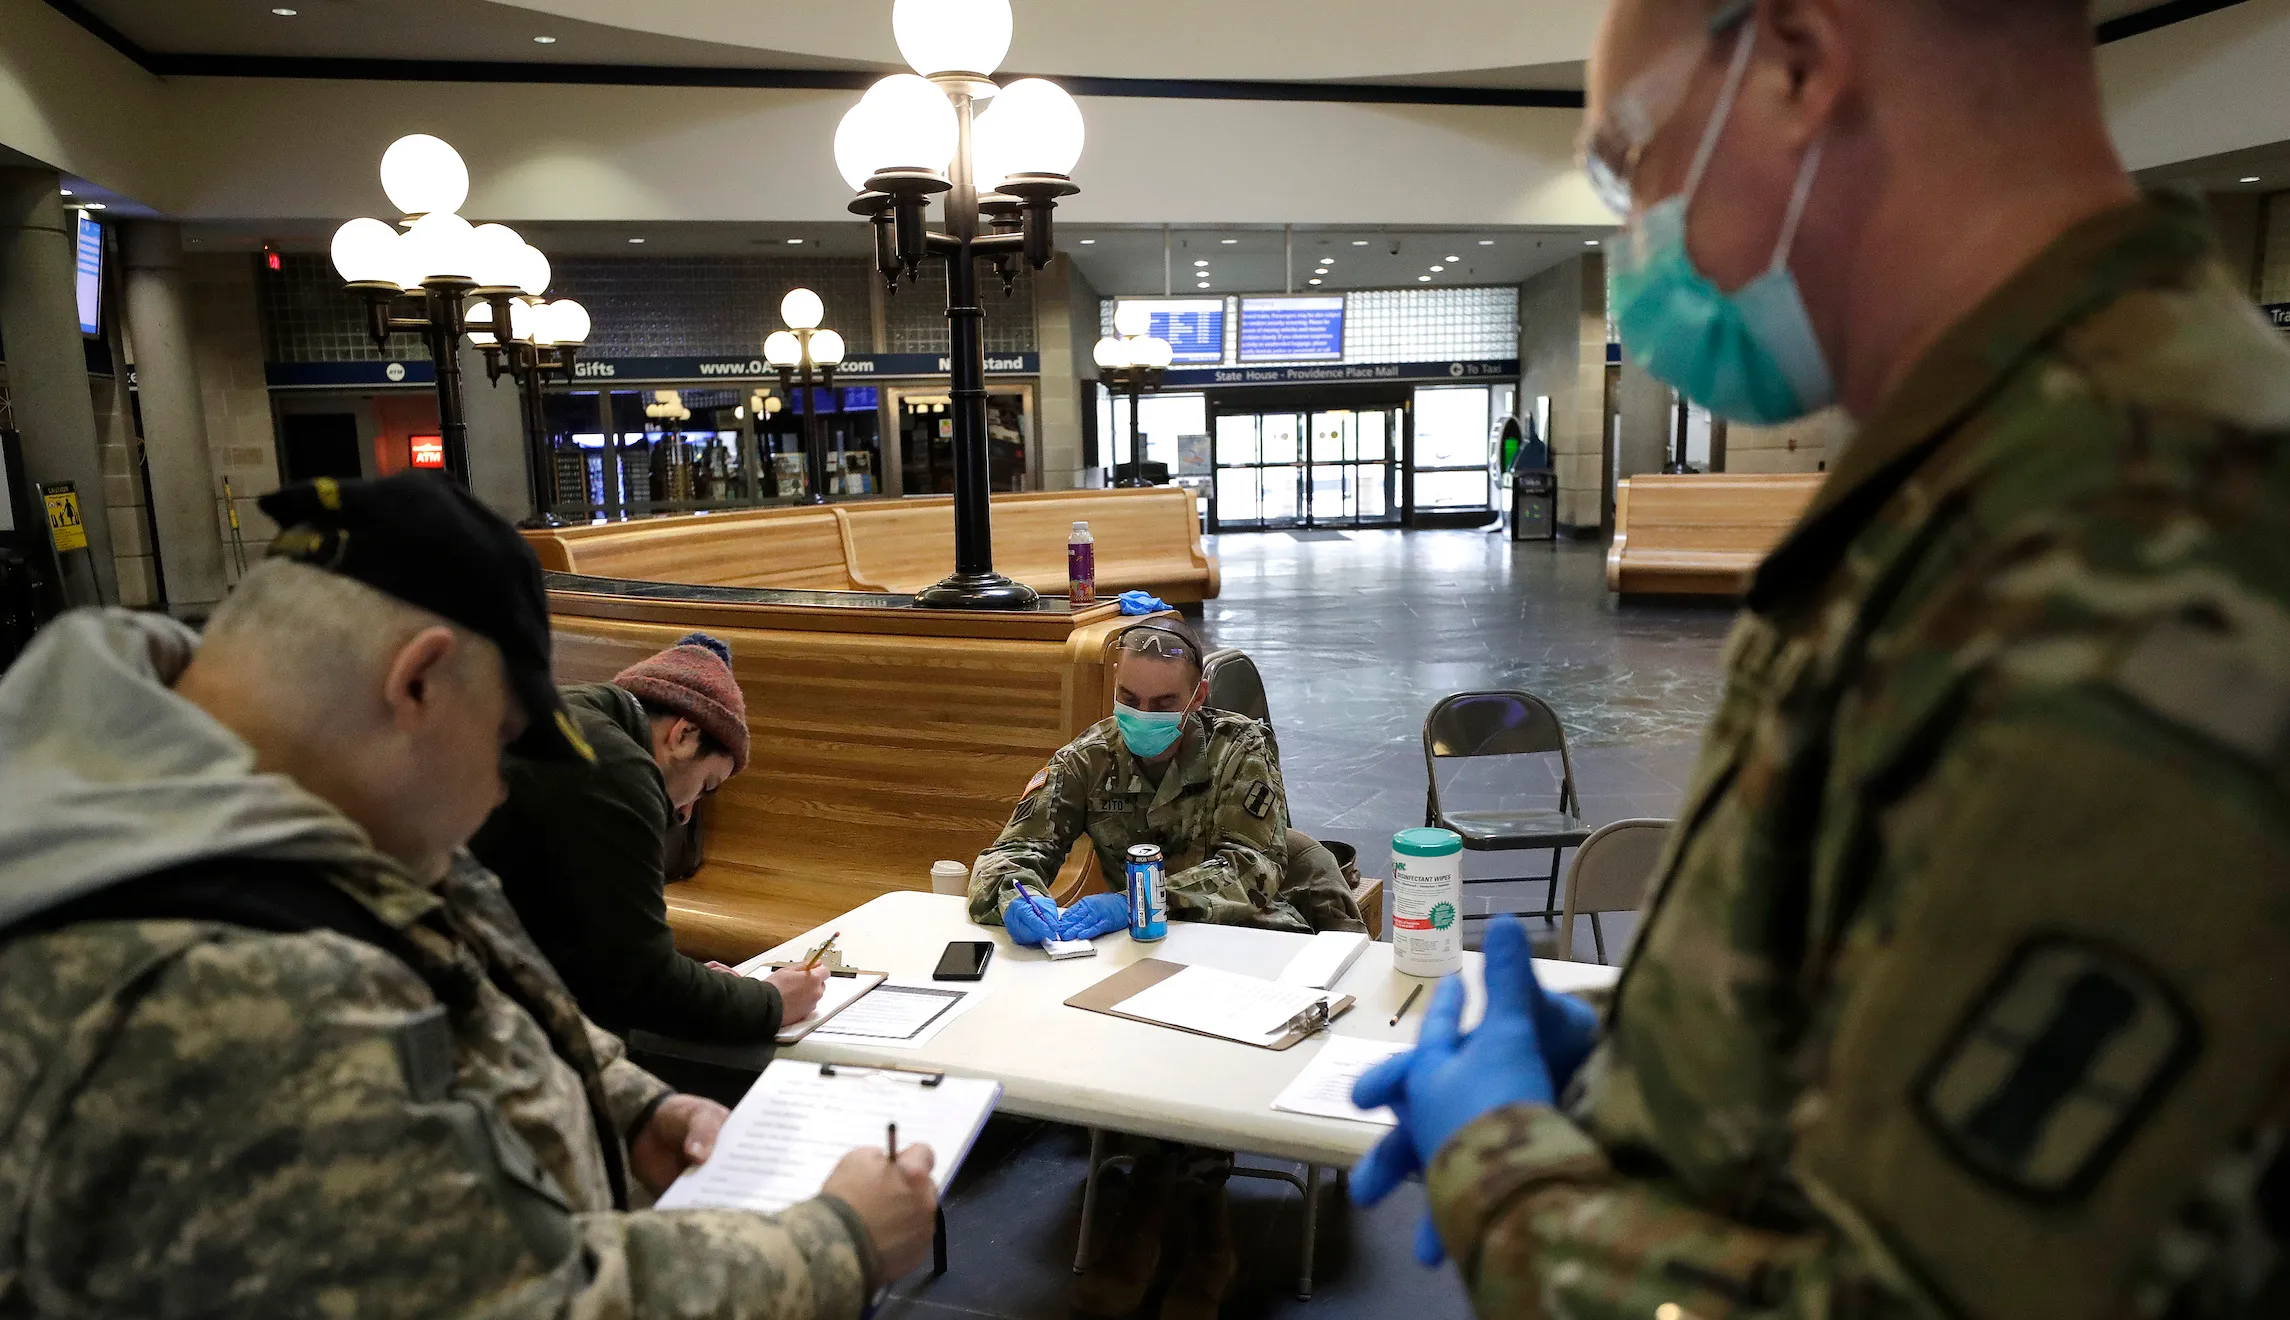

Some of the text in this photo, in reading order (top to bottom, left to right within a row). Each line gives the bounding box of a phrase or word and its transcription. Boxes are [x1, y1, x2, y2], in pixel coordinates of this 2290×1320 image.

[575, 362, 615, 376] Gifts
[938, 356, 1023, 371] Nstand
[1466, 363, 1502, 375] To Taxi
[1215, 371, 1242, 381] State
[1246, 370, 1279, 380] House
[1287, 368, 1343, 379] Providence
[1346, 367, 1373, 377] Place
[1375, 366, 1398, 376] Mall
[416, 452, 440, 462] ATM
[1102, 800, 1123, 811] ZITO
[1398, 872, 1451, 883] DISINFECTANT WIPES
